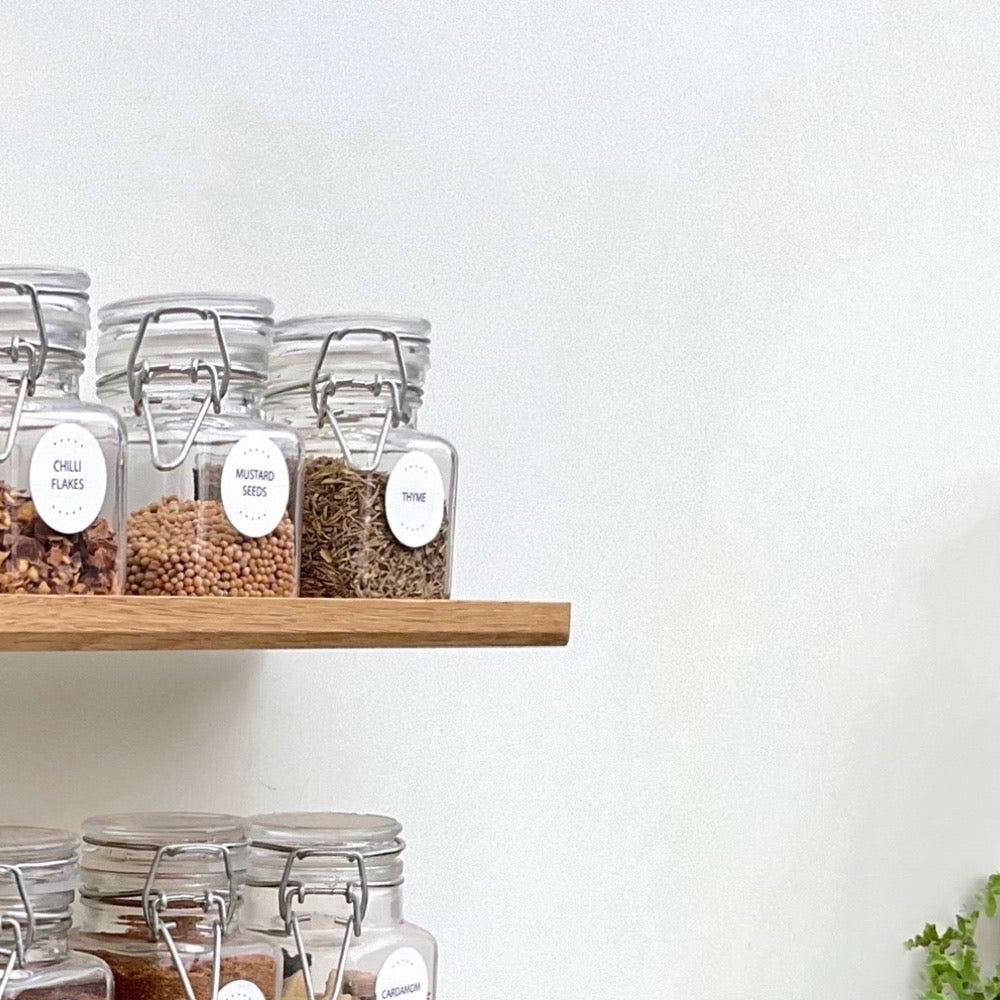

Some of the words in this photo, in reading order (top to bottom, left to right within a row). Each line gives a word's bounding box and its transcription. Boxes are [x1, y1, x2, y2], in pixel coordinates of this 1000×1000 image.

[53, 459, 82, 473] CHILLI
[235, 468, 275, 482] MUSTARD
[51, 477, 85, 491] FLAKES
[242, 484, 268, 498] SEEDS
[402, 491, 426, 503] THYME
[381, 982, 421, 999] CARDAMOM
